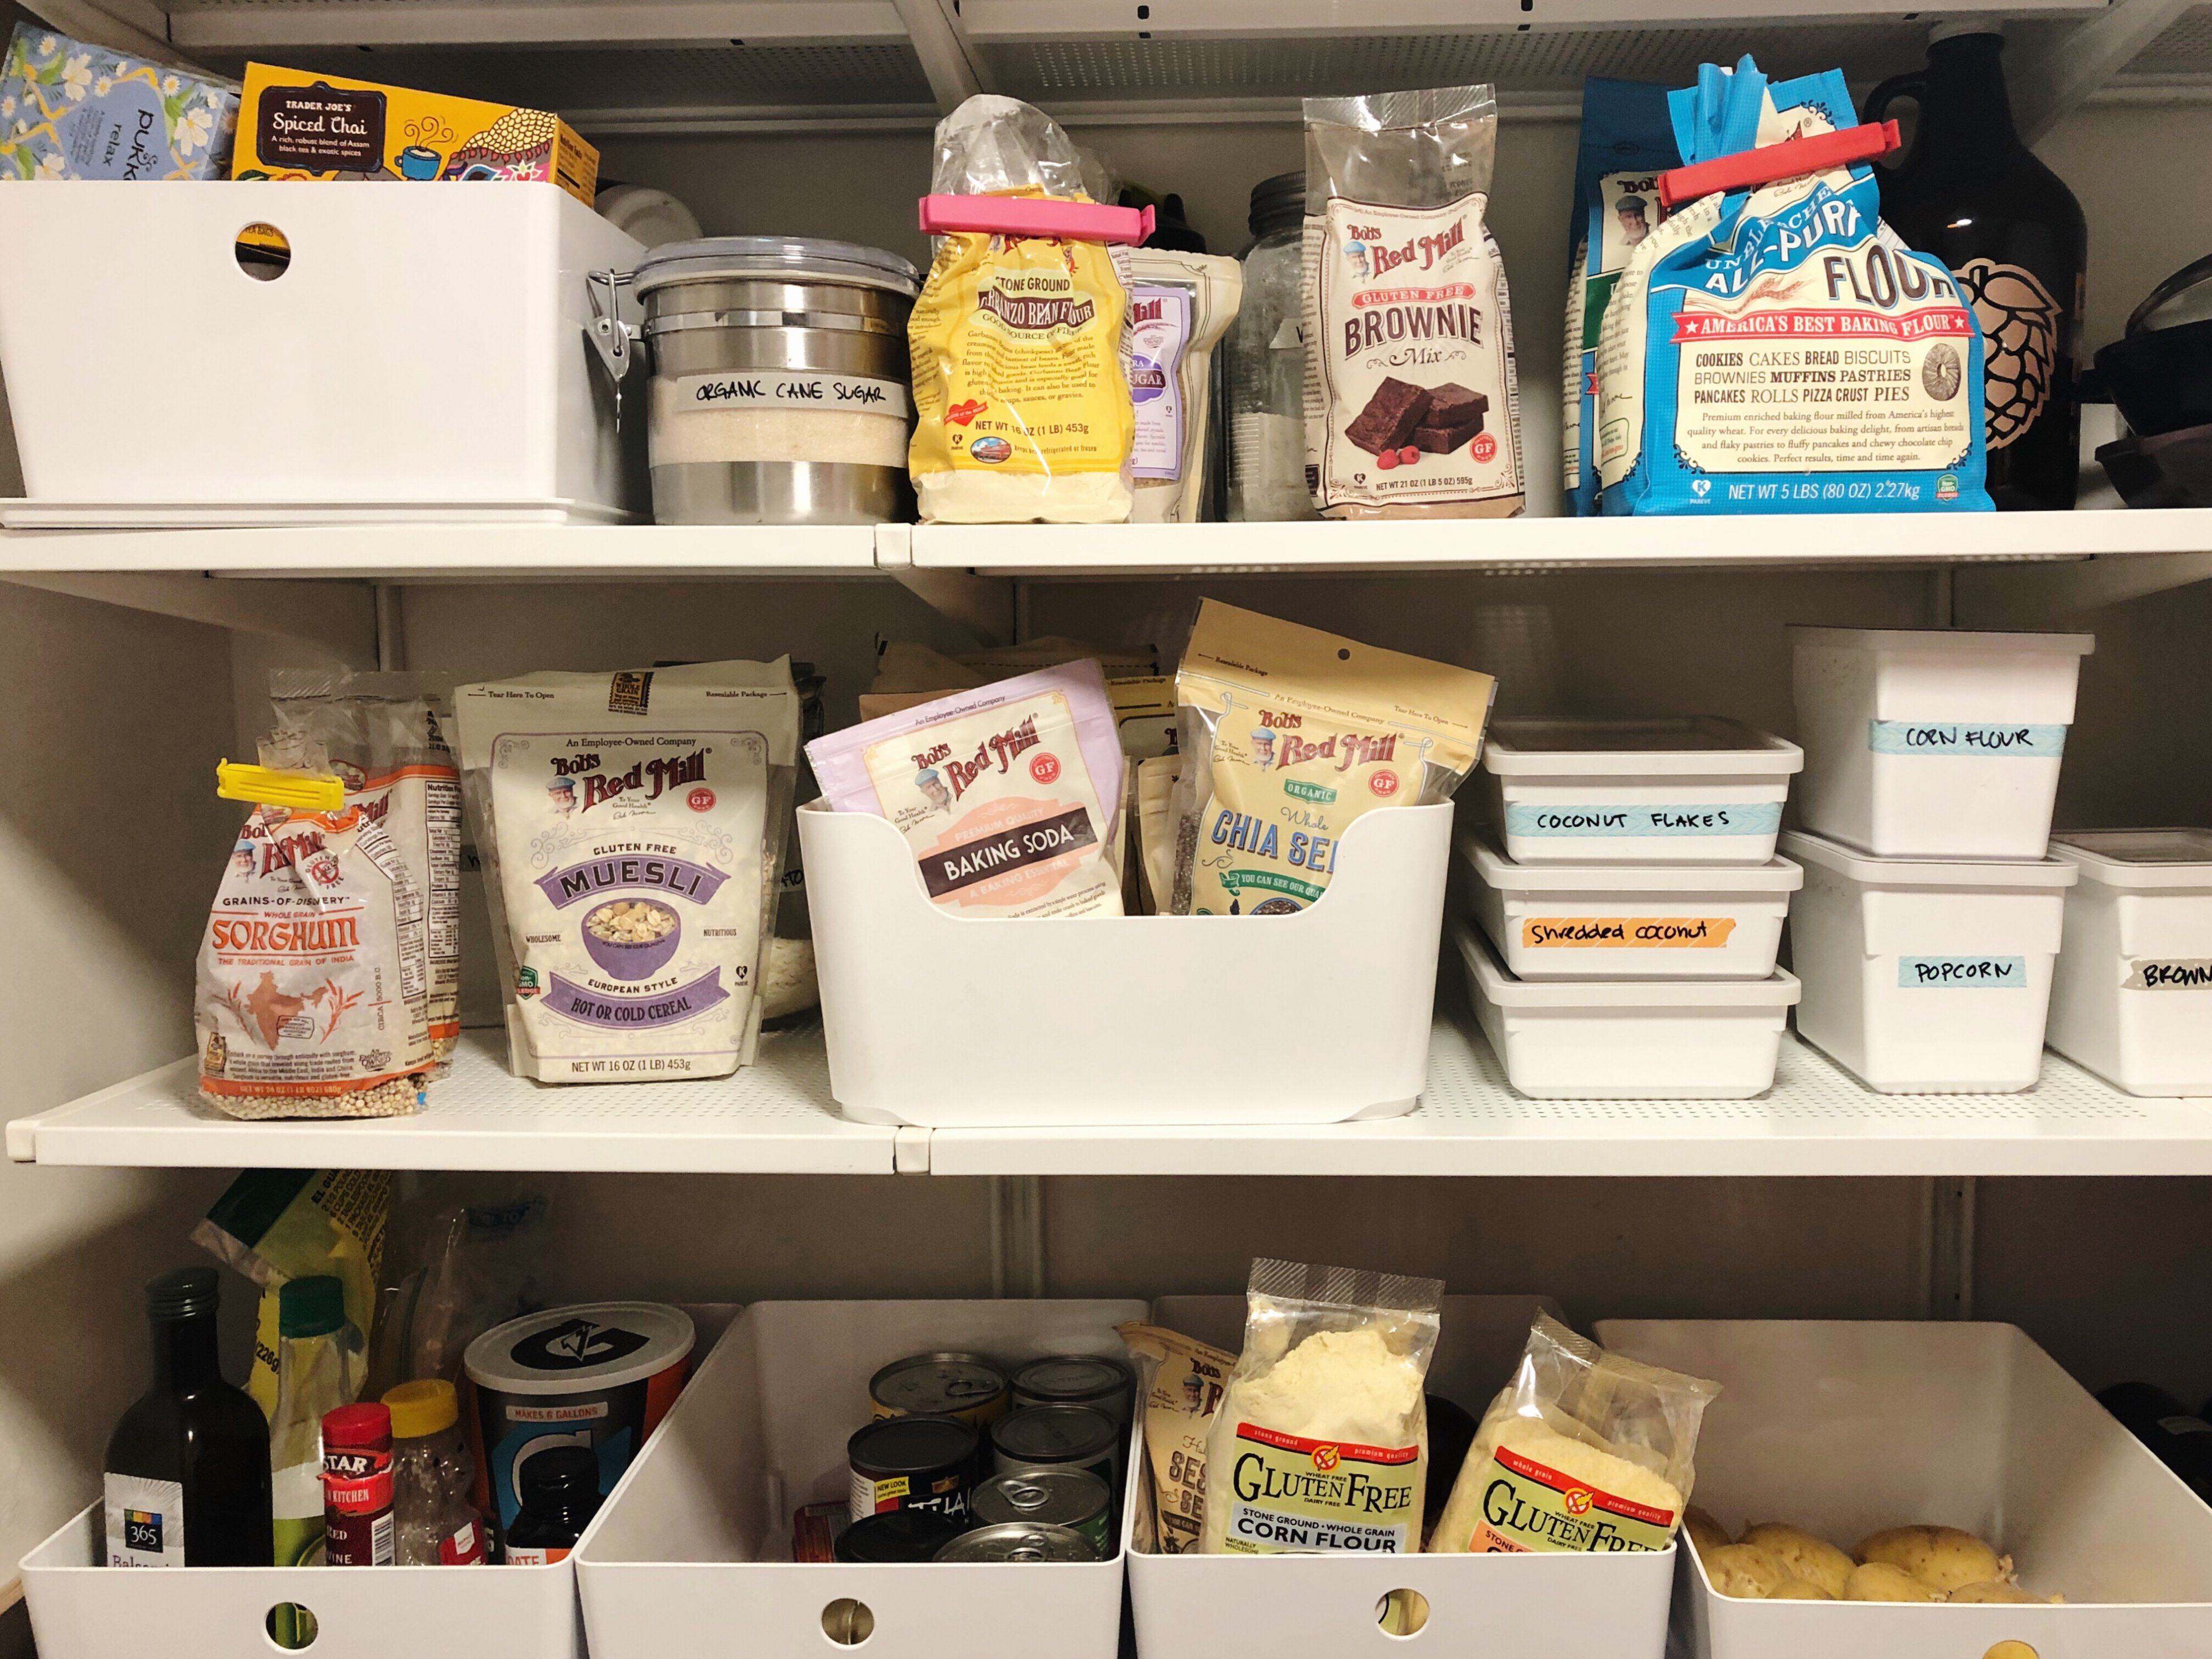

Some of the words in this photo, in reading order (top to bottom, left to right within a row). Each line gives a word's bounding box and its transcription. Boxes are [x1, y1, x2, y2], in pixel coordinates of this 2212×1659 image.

[286, 101, 322, 110] TRADER
[325, 103, 352, 112] JOE'S
[273, 112, 325, 134] Spiced
[331, 117, 367, 134] Chai
[103, 123, 122, 164] relax
[123, 109, 159, 180] pukk
[1347, 224, 1381, 240] Bob's
[1371, 238, 1418, 279] Red
[1418, 217, 1464, 270] Mill
[1027, 277, 1070, 291] GROUND
[1362, 290, 1420, 304] GLUTEN
[1426, 286, 1464, 301] FREE
[1345, 303, 1483, 361] BROWNIE
[1700, 316, 1788, 335] AMERICA'S
[1793, 317, 1835, 332] BEST
[1841, 317, 1898, 335] BAKING
[1389, 347, 1442, 366] Mix
[1696, 353, 1743, 367] COOKIES
[1749, 352, 1801, 366] CAKES
[1805, 351, 1839, 365] BREAD
[1845, 351, 1911, 364] BISCUITS
[1695, 372, 1765, 384] BROWNIES
[1770, 371, 1835, 383] MUFFINS
[1840, 369, 1911, 382] PASTRIES
[776, 382, 823, 399] CANE
[833, 383, 886, 404] SUGAR
[1694, 390, 1745, 404] PANCAKES
[1751, 389, 1798, 403] ROLLS
[1803, 389, 1832, 403] PIZZA
[1836, 388, 1869, 401] CRUST
[1874, 387, 1909, 401] PIES
[1702, 413, 1741, 421] Premium
[1744, 411, 1780, 421] enriched
[1783, 411, 1811, 422] baking
[1814, 411, 1834, 420] flour
[1866, 410, 1886, 419] from
[1888, 410, 1928, 419] America's
[1930, 410, 1954, 420] highest
[975, 421, 992, 430] NET
[995, 421, 1008, 431] WT
[1066, 423, 1089, 434] 453g
[1687, 426, 1716, 437] quality
[1766, 428, 1788, 436] every
[1830, 425, 1858, 436] baking
[1860, 425, 1892, 434] delight,
[1720, 441, 1740, 451] flaky
[1743, 441, 1773, 451] pastries
[1788, 440, 1810, 450] fluffy
[1812, 440, 1849, 451] pancakes
[1870, 439, 1896, 449] chewy
[1898, 437, 1935, 446] chocolate
[1938, 437, 1953, 447] chip
[1738, 454, 1770, 463] cookies.
[1774, 454, 1802, 462] Perfect
[1805, 453, 1833, 463] results,
[1896, 453, 1921, 463] again.
[1376, 482, 1388, 491] NET
[1729, 484, 1756, 499] NET
[1758, 484, 1778, 499] WT
[1793, 484, 1818, 499] LBS
[1823, 483, 1844, 499] (80
[1848, 483, 1871, 498] OZ)
[1875, 482, 1921, 500] 2.27kg
[534, 692, 555, 700] Open
[977, 695, 1005, 710] Company
[1259, 709, 1302, 729] Bob's
[566, 739, 579, 747] An
[581, 738, 654, 747] Employee-Owned
[656, 738, 696, 747] Company
[1906, 727, 1957, 747] CORN
[1965, 728, 2033, 749] FLOUR
[911, 743, 952, 770] Bob's
[943, 741, 994, 801] Red
[989, 715, 1042, 774] Mill
[1276, 733, 1338, 770] Red
[1335, 733, 1399, 772] Mill
[551, 752, 601, 776] Bob's
[582, 761, 644, 813] Red
[645, 748, 706, 800] Mill
[691, 796, 711, 805] GF
[1287, 783, 1332, 801] ORGANIC
[1281, 806, 1329, 831] Whole
[1537, 813, 1628, 828] COCONUT
[1651, 811, 1730, 828] FLAKES
[1211, 810, 1279, 860] CHIA
[593, 843, 641, 855] GLUTEN
[646, 844, 677, 854] FREE
[943, 839, 1021, 881] BAKING
[1023, 824, 1075, 854] SODA
[560, 860, 703, 899] MUESLI
[1241, 874, 1255, 883] YOU
[1257, 875, 1272, 885] CAN
[1274, 878, 1288, 888] SEE
[1290, 881, 1304, 893] OUR
[212, 916, 360, 951] SORGHUM
[526, 935, 561, 943] WHOLESOME
[703, 928, 737, 937] NUTRITIOUS
[1531, 925, 1625, 945] Shredded
[1635, 920, 1707, 939] coconut
[218, 957, 233, 966] THE
[238, 957, 285, 966] TRADITIONAL
[289, 958, 311, 967] GRAIN
[331, 954, 354, 964] INDIA
[1915, 963, 2012, 983] POPCORN
[588, 979, 640, 993] EUROPEAN
[644, 977, 678, 992] STYLE
[571, 997, 594, 1016] HOT
[596, 1003, 612, 1019] OR
[614, 1006, 645, 1021] COLD
[648, 997, 692, 1019] CEREAL
[572, 1061, 591, 1073] NET
[592, 1061, 606, 1072] WT
[608, 1061, 620, 1071] 16
[623, 1061, 635, 1071] OZ
[638, 1060, 647, 1072] (1
[650, 1060, 665, 1071] LB)
[667, 1059, 691, 1071] 453g
[515, 1408, 544, 1421] MAKES
[555, 1406, 598, 1420] GALLONS
[333, 1489, 369, 1503] KITCHEN
[1243, 1508, 1275, 1522] STONE
[1277, 1516, 1319, 1529] GROUND
[1326, 1524, 1363, 1535] WHOLE
[1365, 1528, 1395, 1537] GRAIN
[131, 1525, 156, 1545] 365
[1226, 1537, 1256, 1548] NATURALLY
[1238, 1518, 1307, 1544] CORN
[1316, 1532, 1396, 1553] FLOUR
[1485, 1530, 1515, 1552] STONE
[1547, 1537, 1566, 1547] DAIRY
[1225, 1543, 1259, 1554] WHOLESOME
